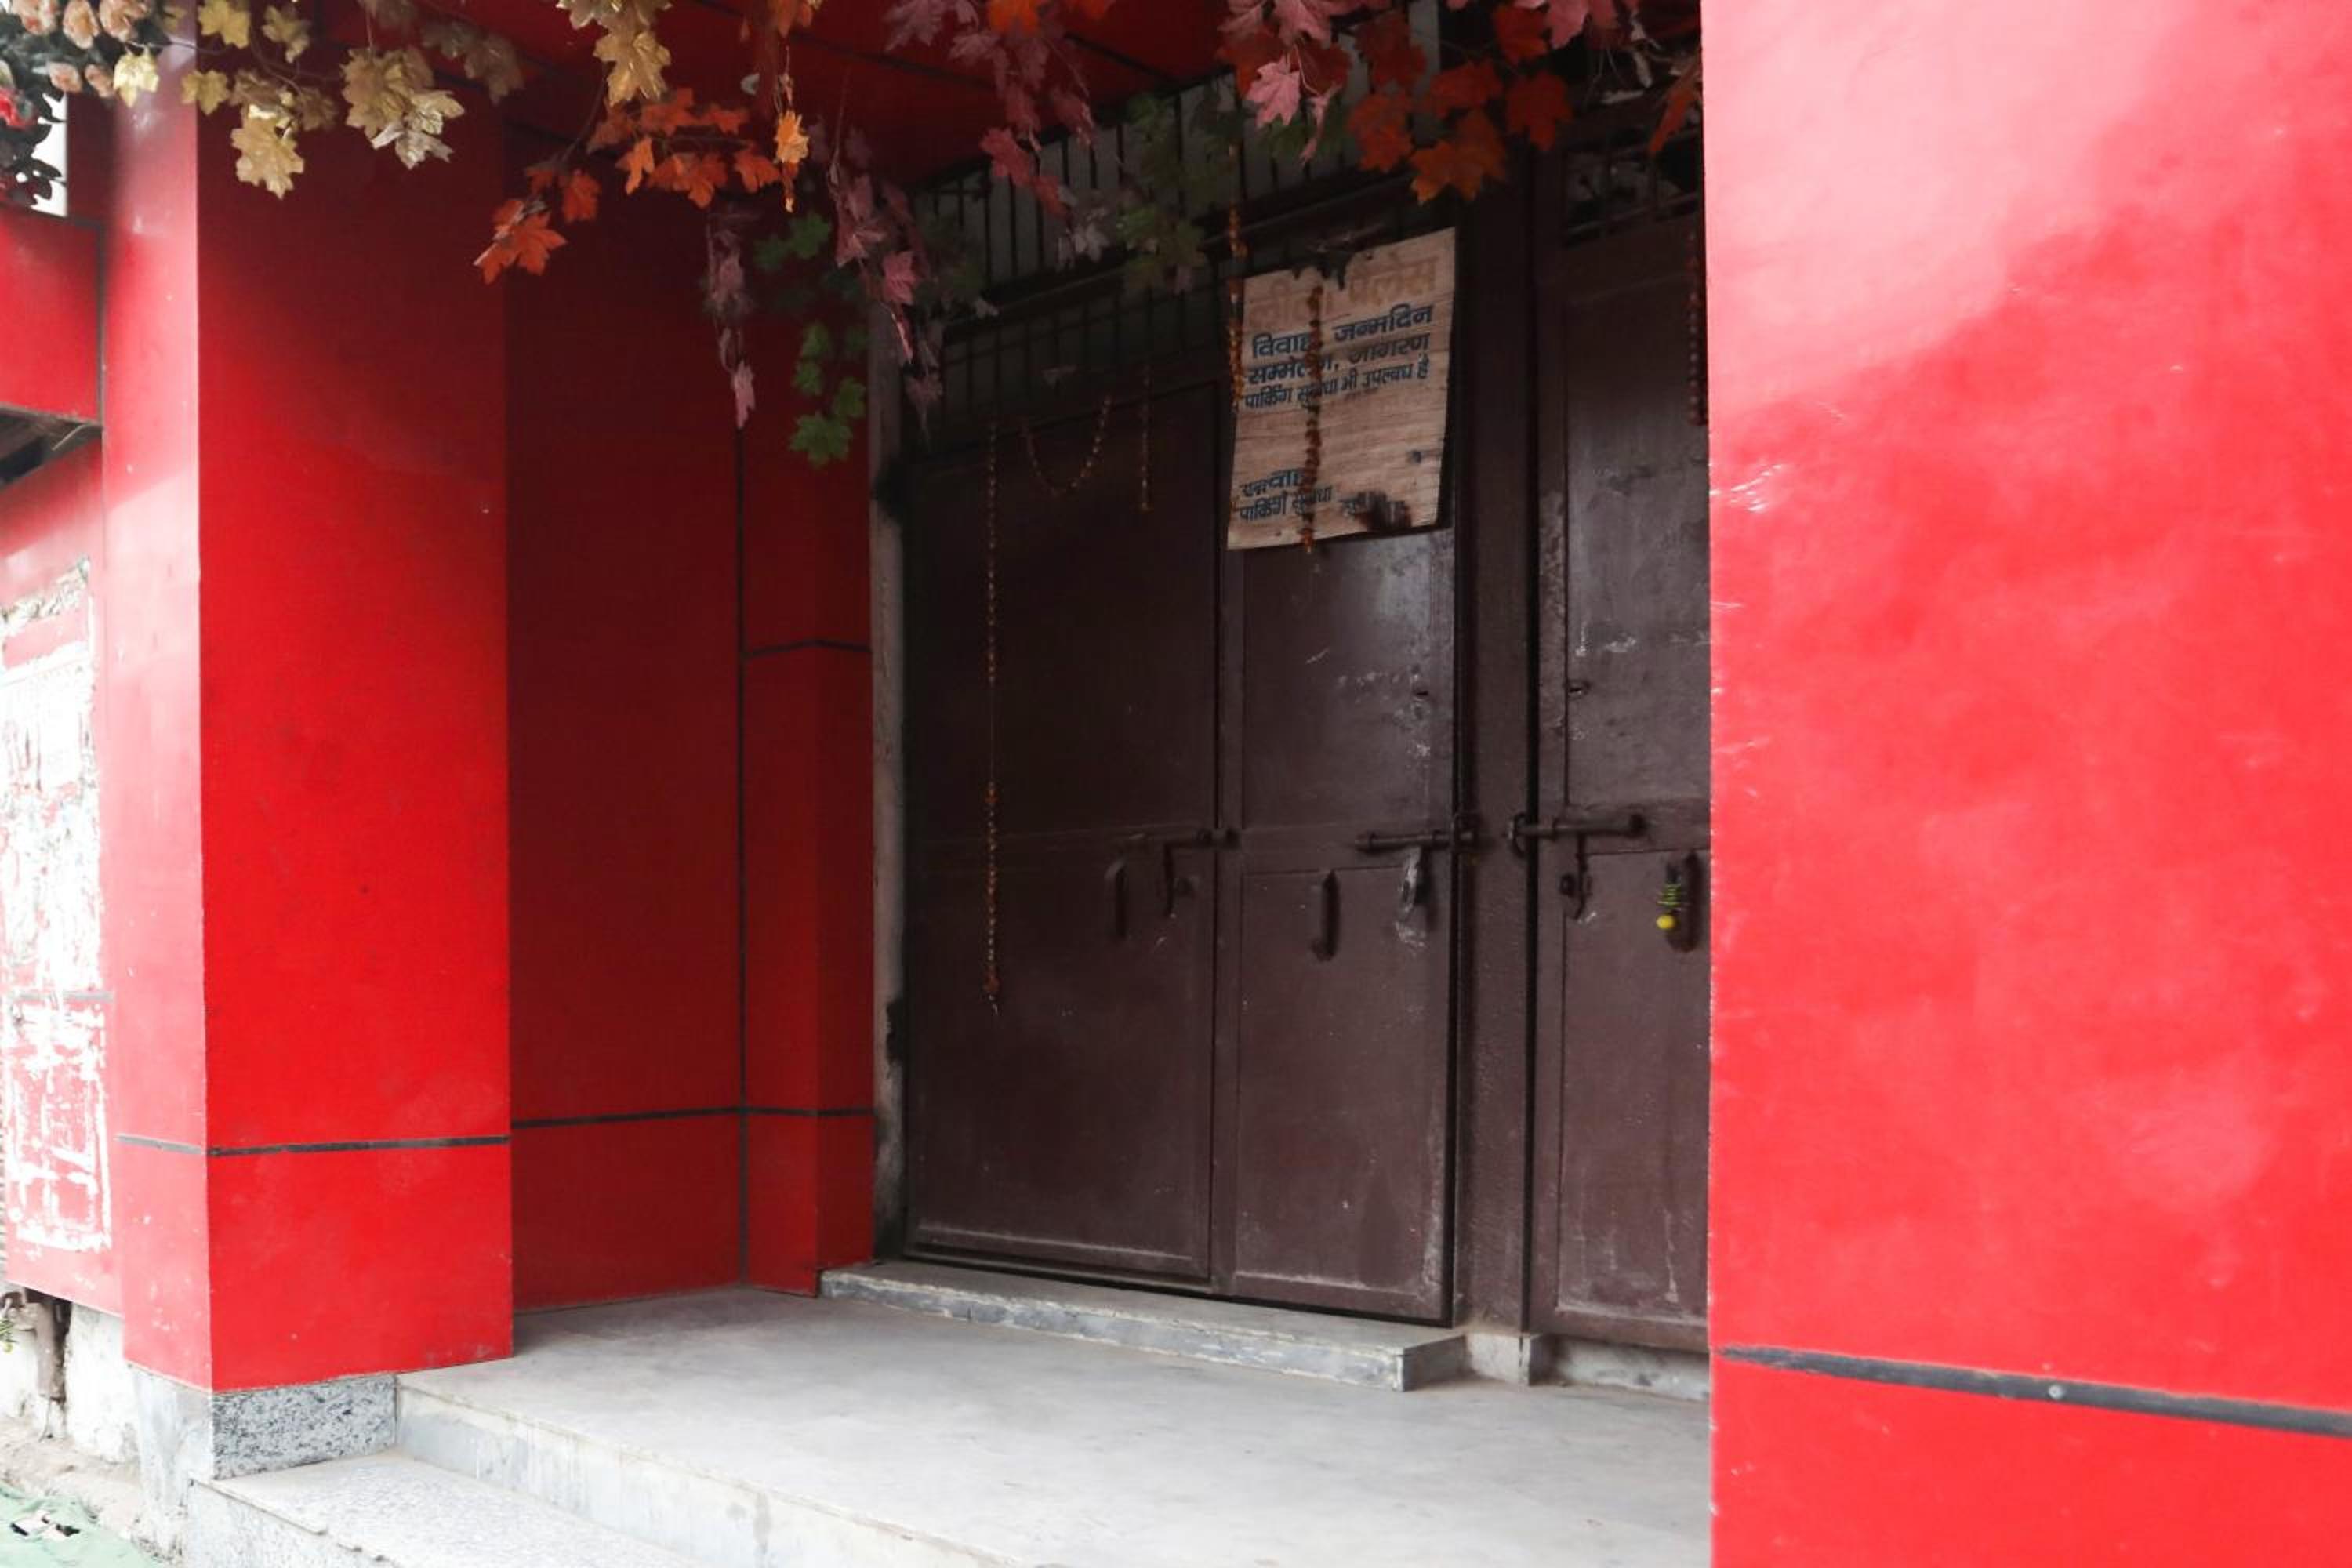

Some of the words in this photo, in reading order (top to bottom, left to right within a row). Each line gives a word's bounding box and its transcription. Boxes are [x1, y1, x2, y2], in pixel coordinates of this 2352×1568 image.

[1332, 303, 1434, 343] जन्मदिन
[1341, 368, 1357, 393] भी
[1417, 354, 1430, 380] है
